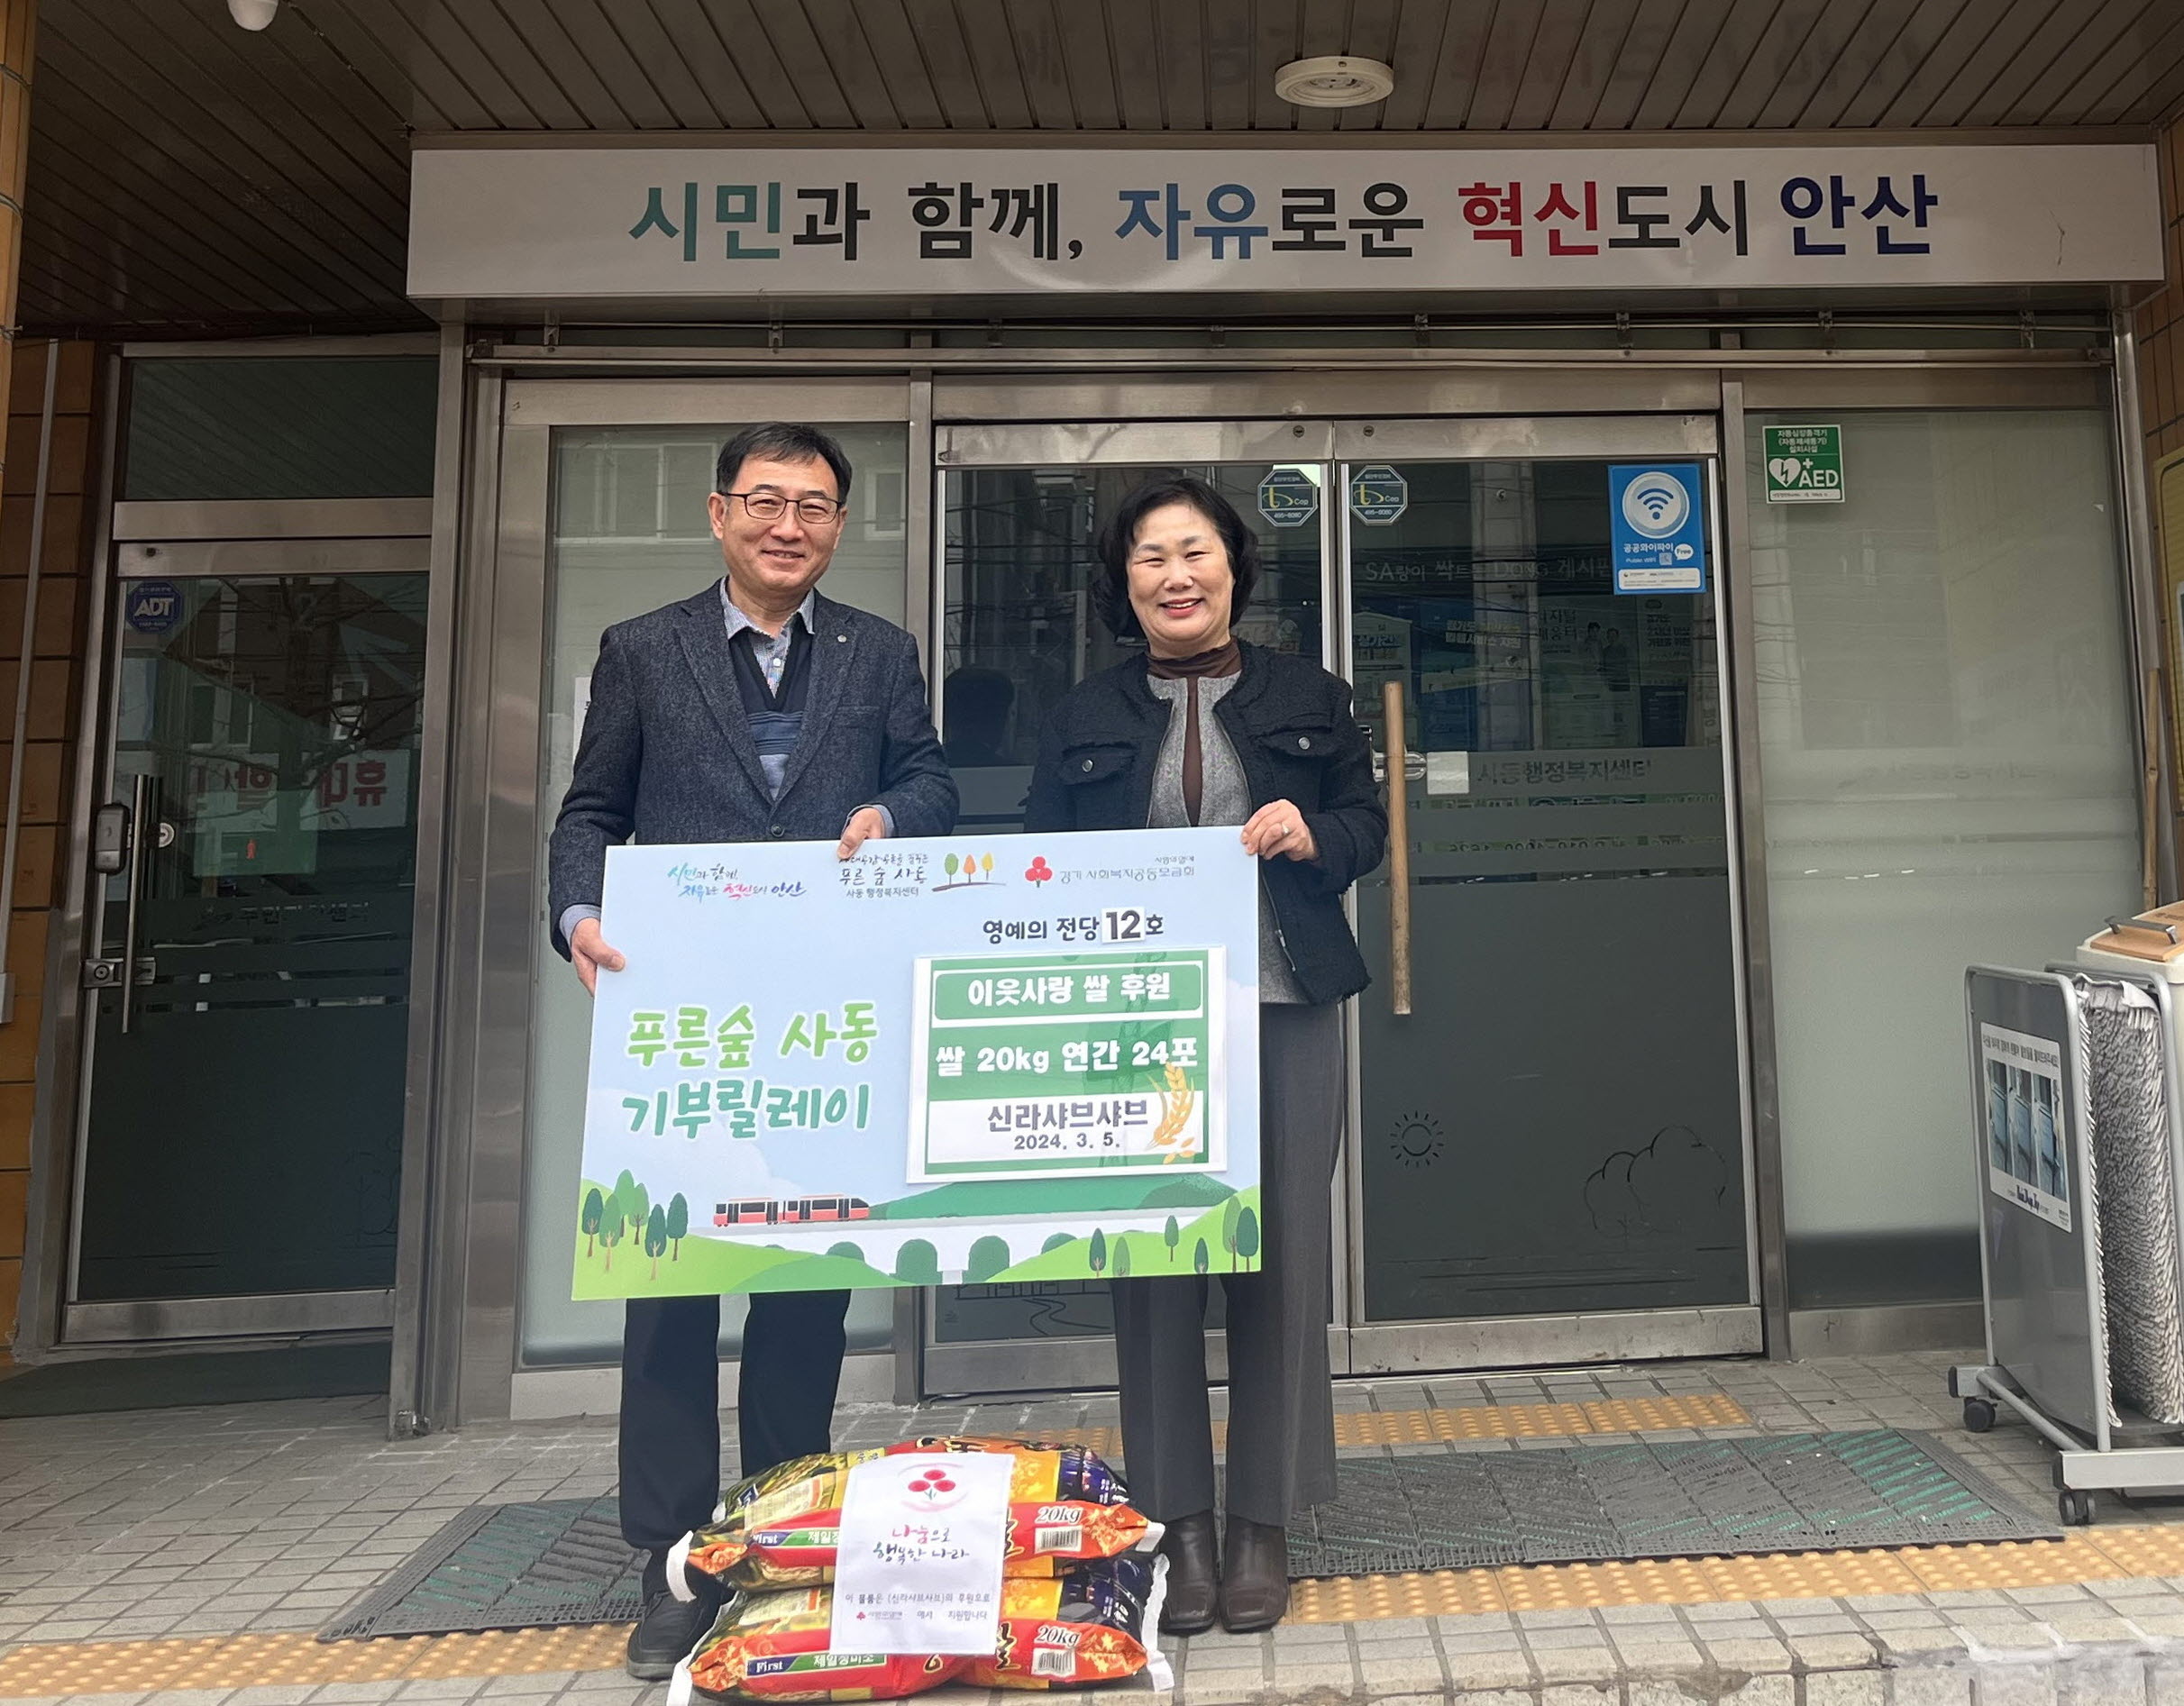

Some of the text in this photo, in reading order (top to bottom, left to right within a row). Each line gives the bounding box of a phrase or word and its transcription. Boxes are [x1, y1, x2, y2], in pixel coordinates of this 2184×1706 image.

[628, 174, 1938, 262] 시민과 함께, 자유로운 혁신도시 안산
[1798, 470, 1840, 488] AED
[1623, 543, 1675, 554] 공공와이파이
[134, 598, 175, 616] ADT
[839, 868, 865, 886] 푸른
[893, 866, 928, 884] 사동
[1085, 865, 1195, 882] 사회복지공동모금회
[771, 880, 808, 898] 안산
[982, 918, 1048, 944] 영예의
[967, 972, 1171, 1008] 이웃사랑 쌀 후원
[626, 1002, 878, 1070] 푸른숲 사동
[935, 1036, 1199, 1078] 쌀 20kg 연간 24포
[621, 1079, 870, 1140] 기부릴레이
[987, 1099, 1149, 1133] 신라샤브샤브
[1013, 1133, 1068, 1152] 2024.
[1036, 1506, 1083, 1523] 20kg
[891, 1524, 952, 1545] 나눔으로
[873, 1541, 971, 1565] 행복한 나라
[1036, 1625, 1082, 1648] 20kg
[755, 1660, 783, 1674] First
